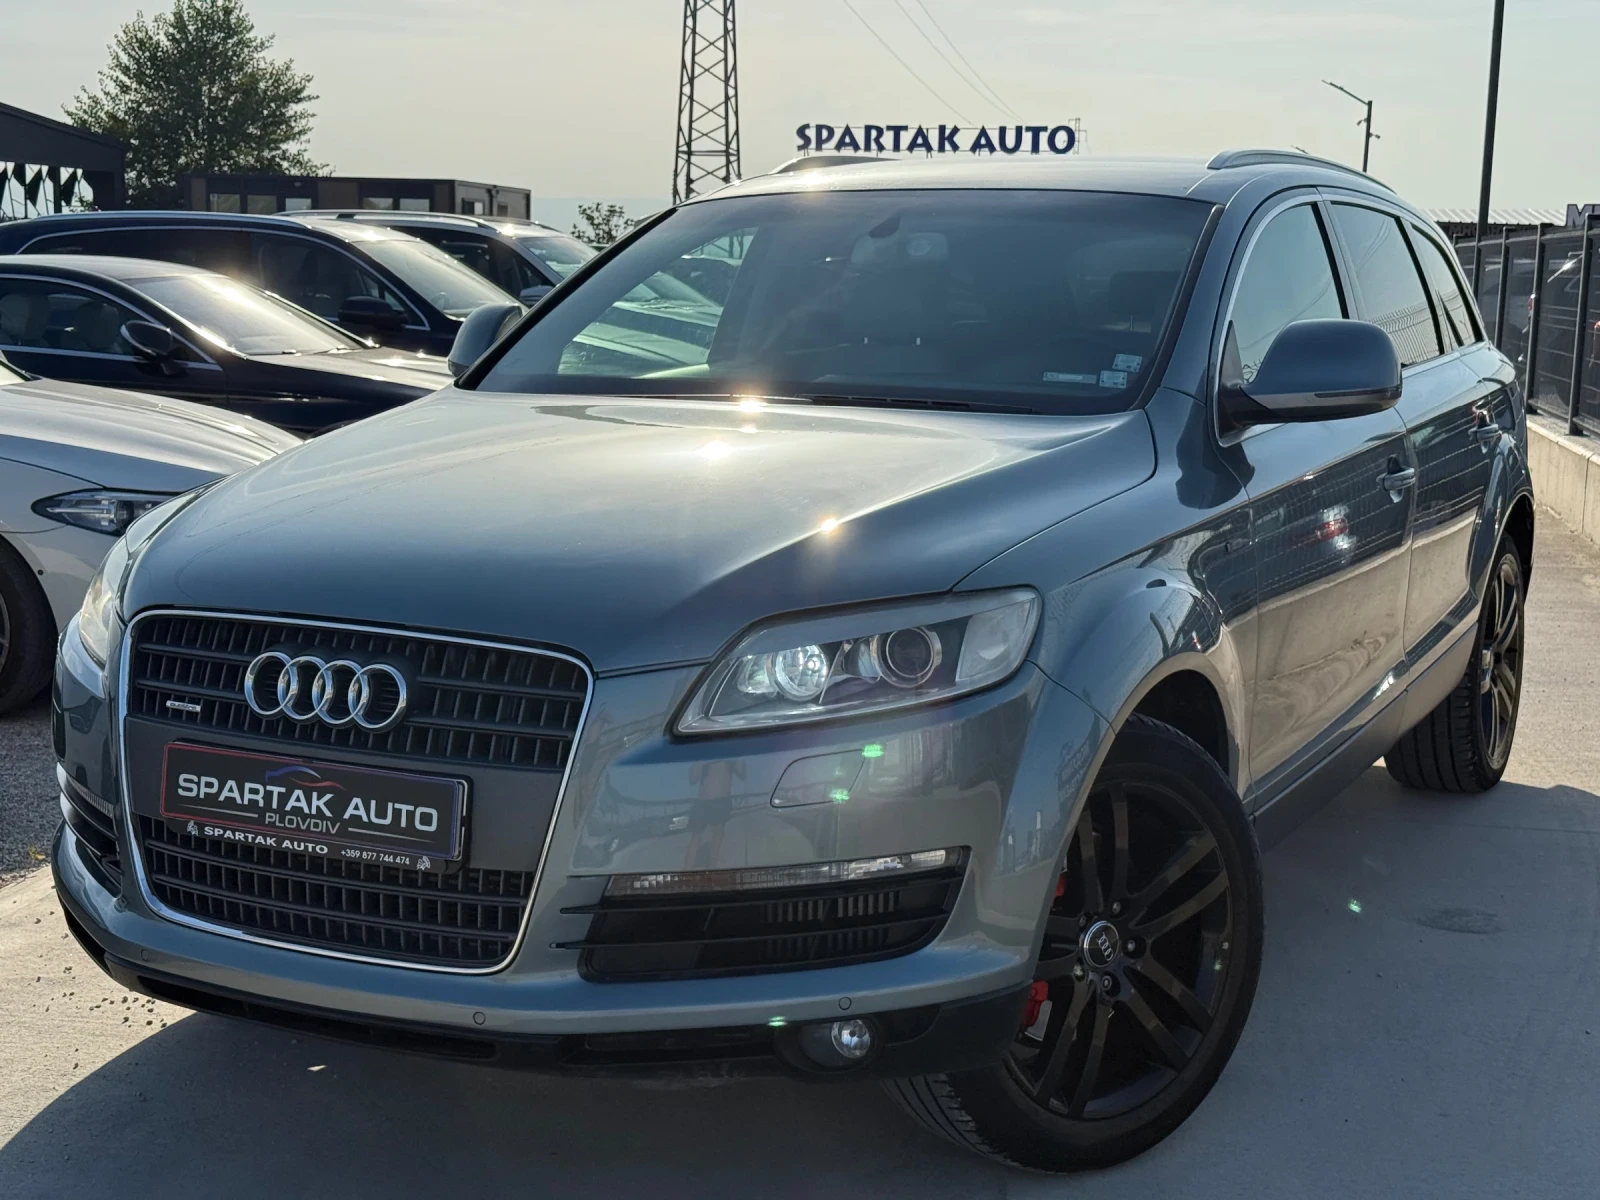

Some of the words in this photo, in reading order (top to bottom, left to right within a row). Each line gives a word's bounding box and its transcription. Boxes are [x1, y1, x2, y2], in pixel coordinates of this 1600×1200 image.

[796, 123, 960, 153] SPARTAK
[969, 124, 1076, 154] AUTO
[177, 774, 335, 817] SPARTAK
[343, 797, 438, 832] AUTO
[265, 812, 341, 835] PLOVDIV
[204, 826, 277, 846] SPARTAK
[281, 839, 328, 854] AUTO
[340, 849, 360, 859] +359
[362, 851, 377, 861] 877
[379, 853, 394, 863] 744
[395, 855, 410, 866] 474
